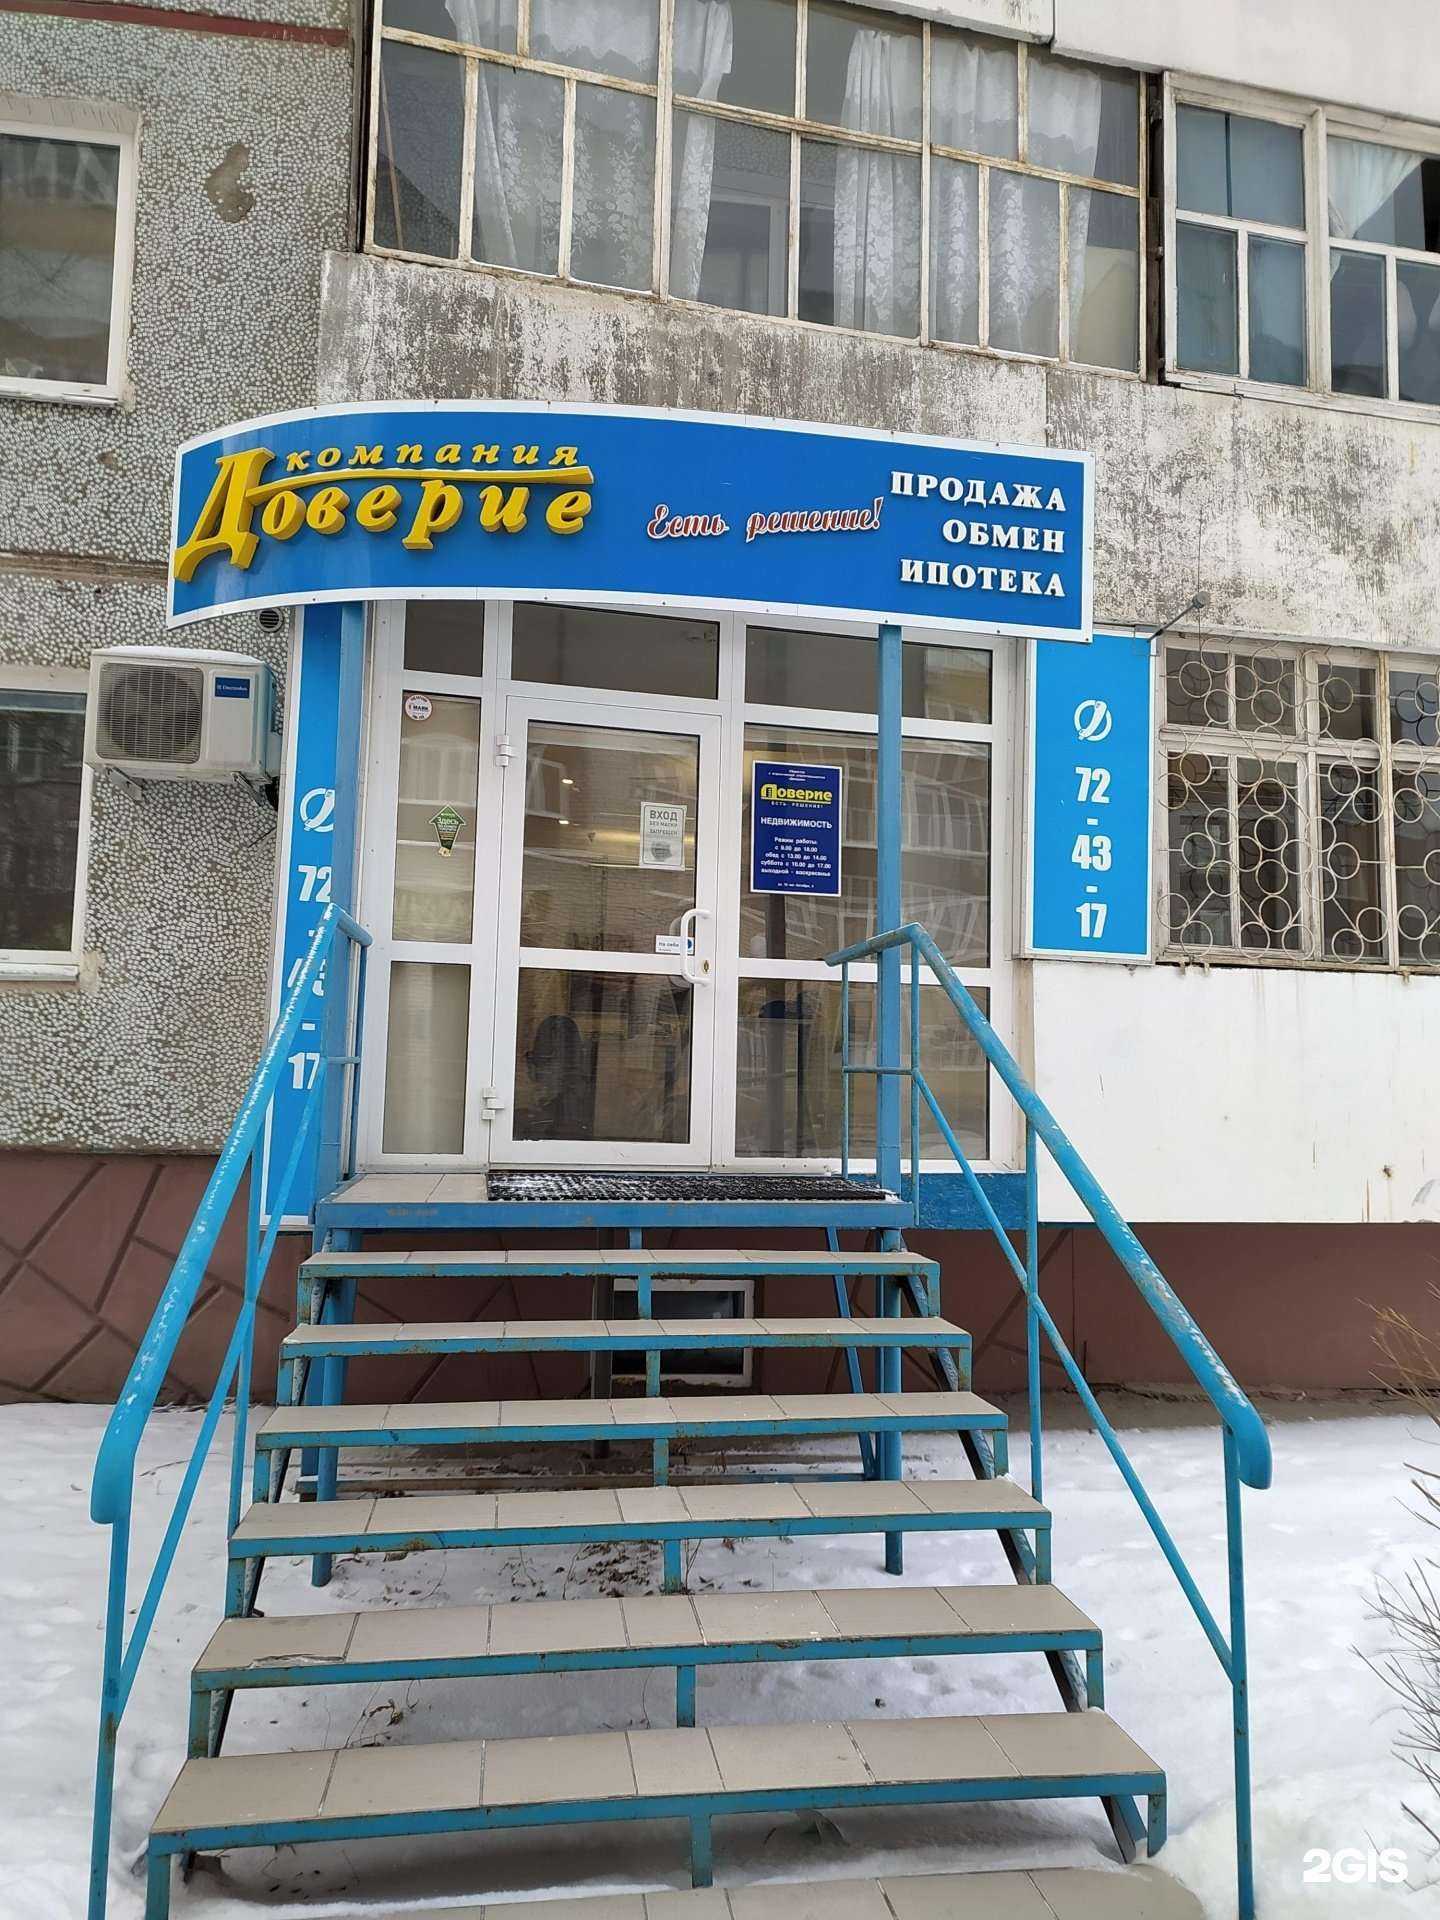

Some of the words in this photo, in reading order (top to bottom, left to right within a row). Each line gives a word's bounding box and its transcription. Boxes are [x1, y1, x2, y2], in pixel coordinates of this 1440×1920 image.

[286, 443, 579, 472] компания
[890, 470, 1067, 512] ПРОДАЖА
[173, 447, 595, 582] Доверие
[647, 504, 729, 540] Есть
[745, 496, 884, 543] решение!
[942, 518, 1066, 554] ОБМЕН
[900, 558, 1066, 598] ИПОТЕКА
[1075, 766, 1111, 804] 72
[650, 810, 677, 821] ВХОД
[761, 816, 832, 829] НЕДВИЖИМОСТЬ
[1071, 834, 1112, 871] 43
[298, 865, 332, 903] 72
[1075, 902, 1108, 939] 17
